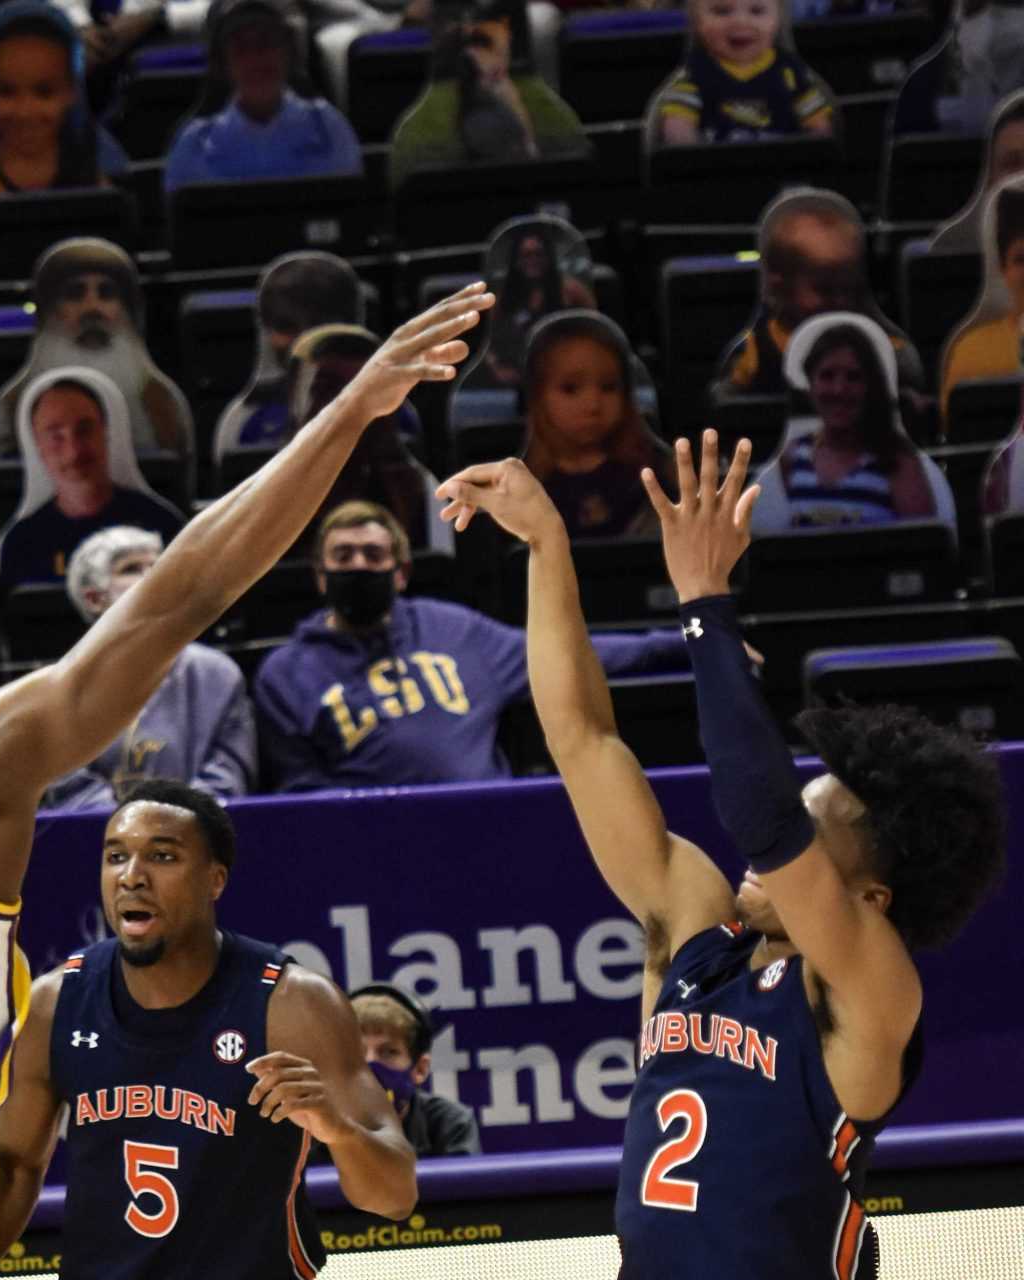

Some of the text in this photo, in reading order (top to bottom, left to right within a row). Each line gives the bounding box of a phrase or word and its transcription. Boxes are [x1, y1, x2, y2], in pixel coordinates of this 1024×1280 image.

[216, 1032, 244, 1061] SEC
[639, 1012, 778, 1081] AUBURN
[76, 1085, 236, 1137] AUBURN
[642, 1089, 708, 1212] 2
[123, 1139, 180, 1239] 5
[320, 1214, 502, 1250] RoofClaim.com
